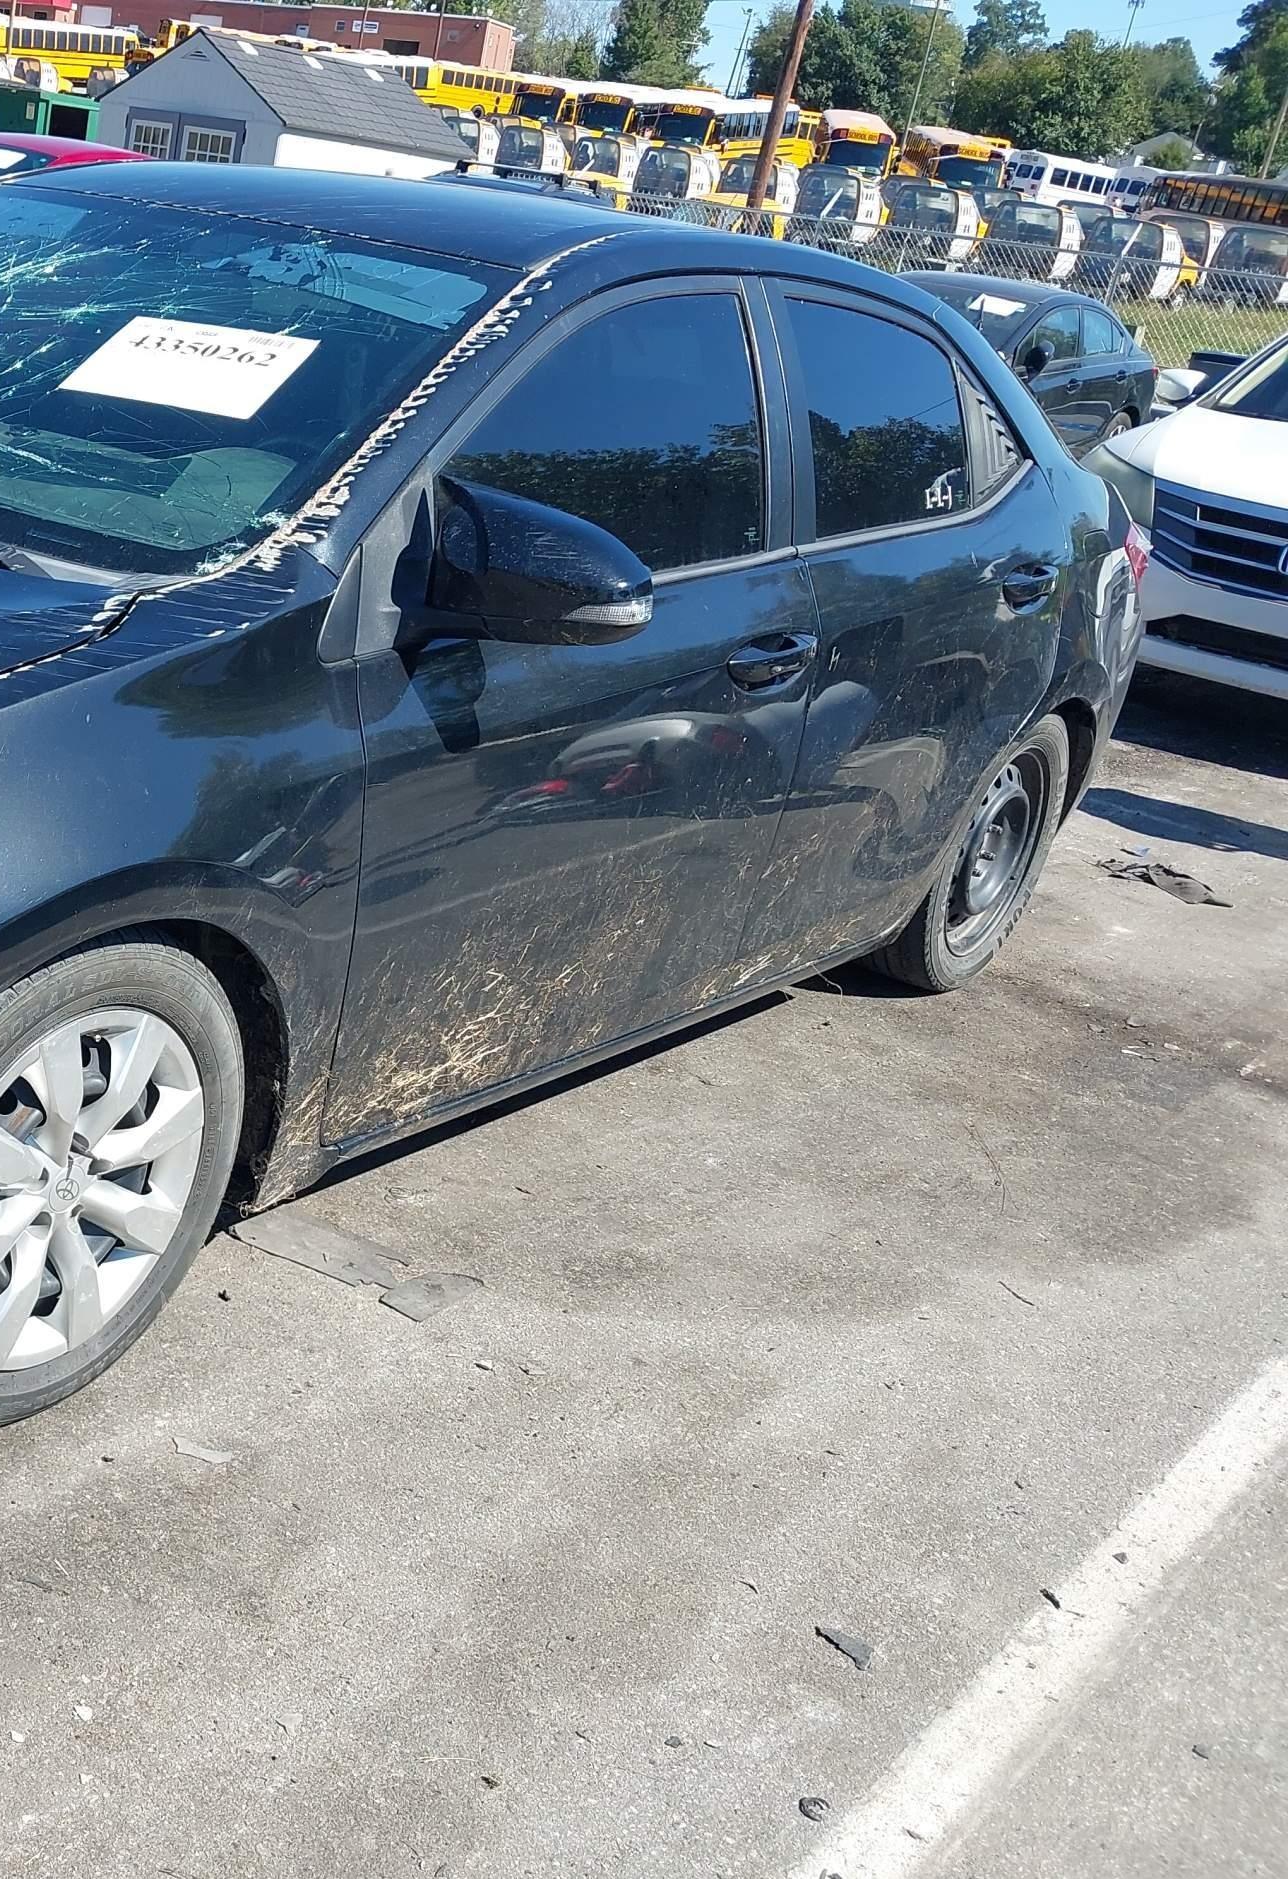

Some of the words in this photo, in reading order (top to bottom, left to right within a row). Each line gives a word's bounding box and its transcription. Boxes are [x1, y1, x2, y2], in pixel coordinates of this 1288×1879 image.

[848, 130, 867, 139] SCHOOL
[868, 133, 878, 141] BUS
[958, 147, 977, 157] SCHOOL
[979, 151, 990, 159] BUS
[128, 334, 277, 367] 43350262
